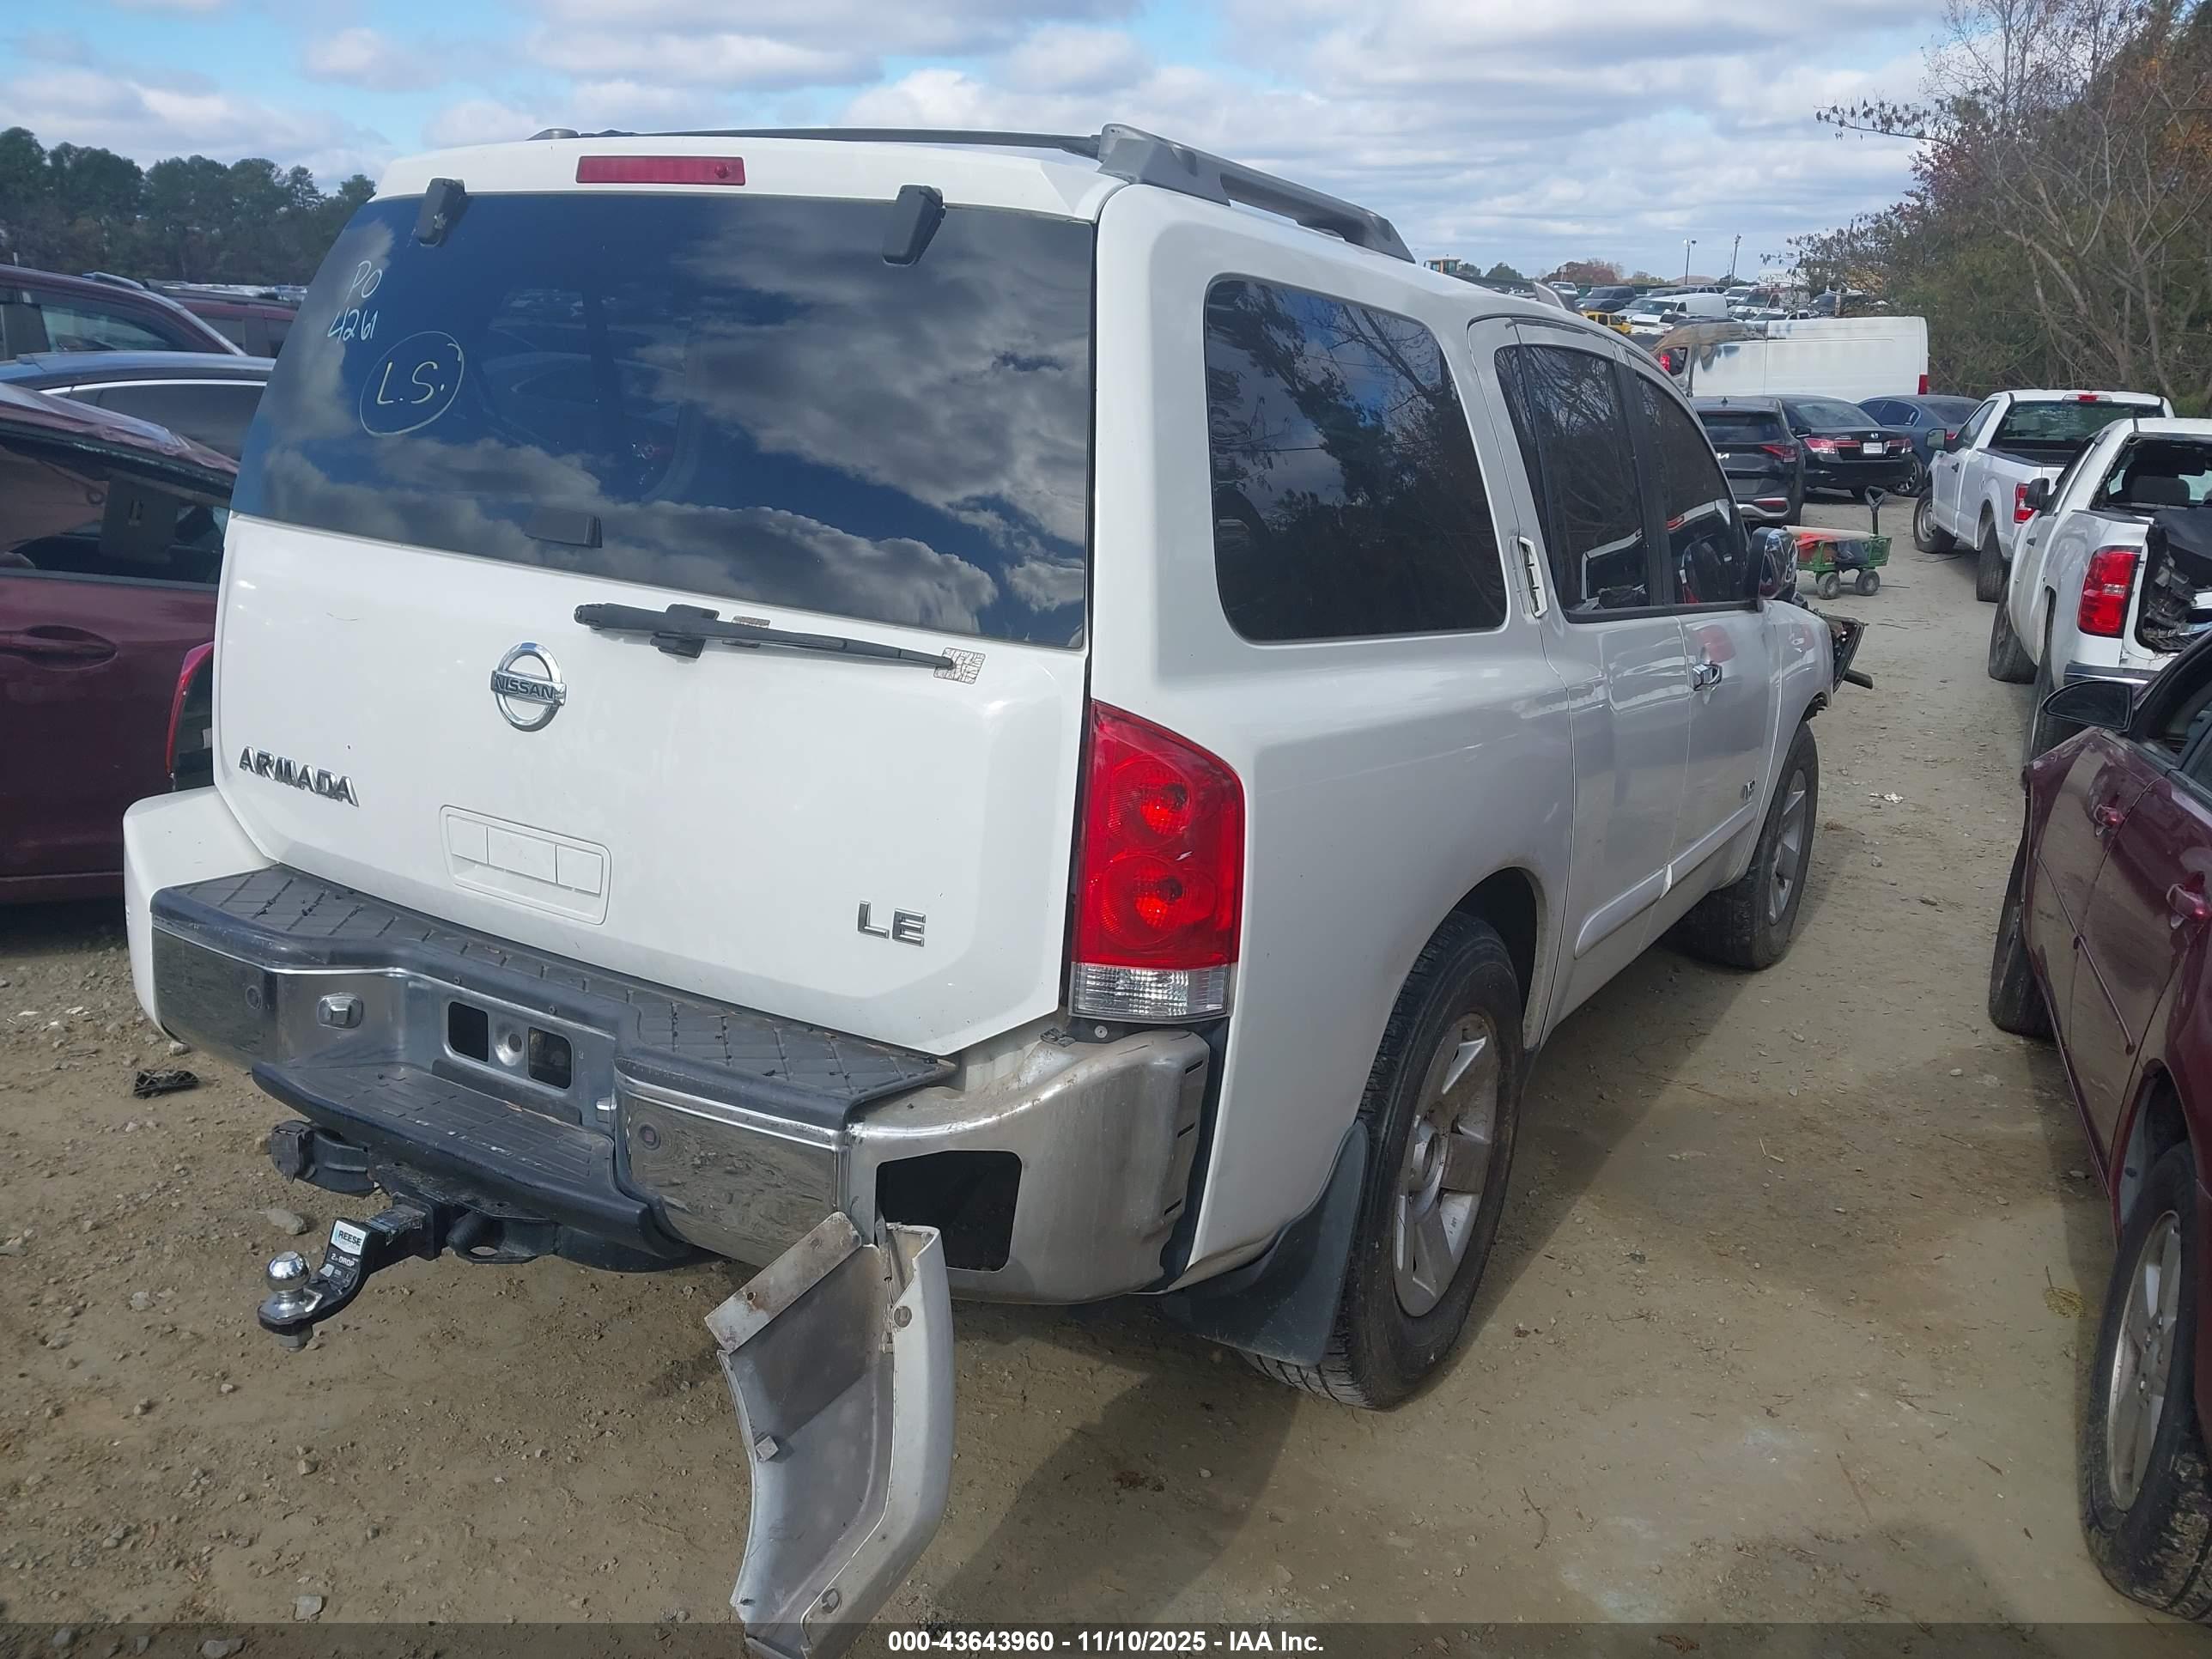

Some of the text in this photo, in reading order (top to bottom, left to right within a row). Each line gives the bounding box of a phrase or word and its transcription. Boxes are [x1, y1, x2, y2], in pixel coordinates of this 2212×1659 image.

[327, 307, 379, 343] 4261
[495, 673, 555, 700] NISSAN
[239, 745, 359, 807] ARMADA
[858, 900, 927, 947] LE
[338, 1230, 362, 1247] REESE
[338, 1255, 355, 1267] DROP
